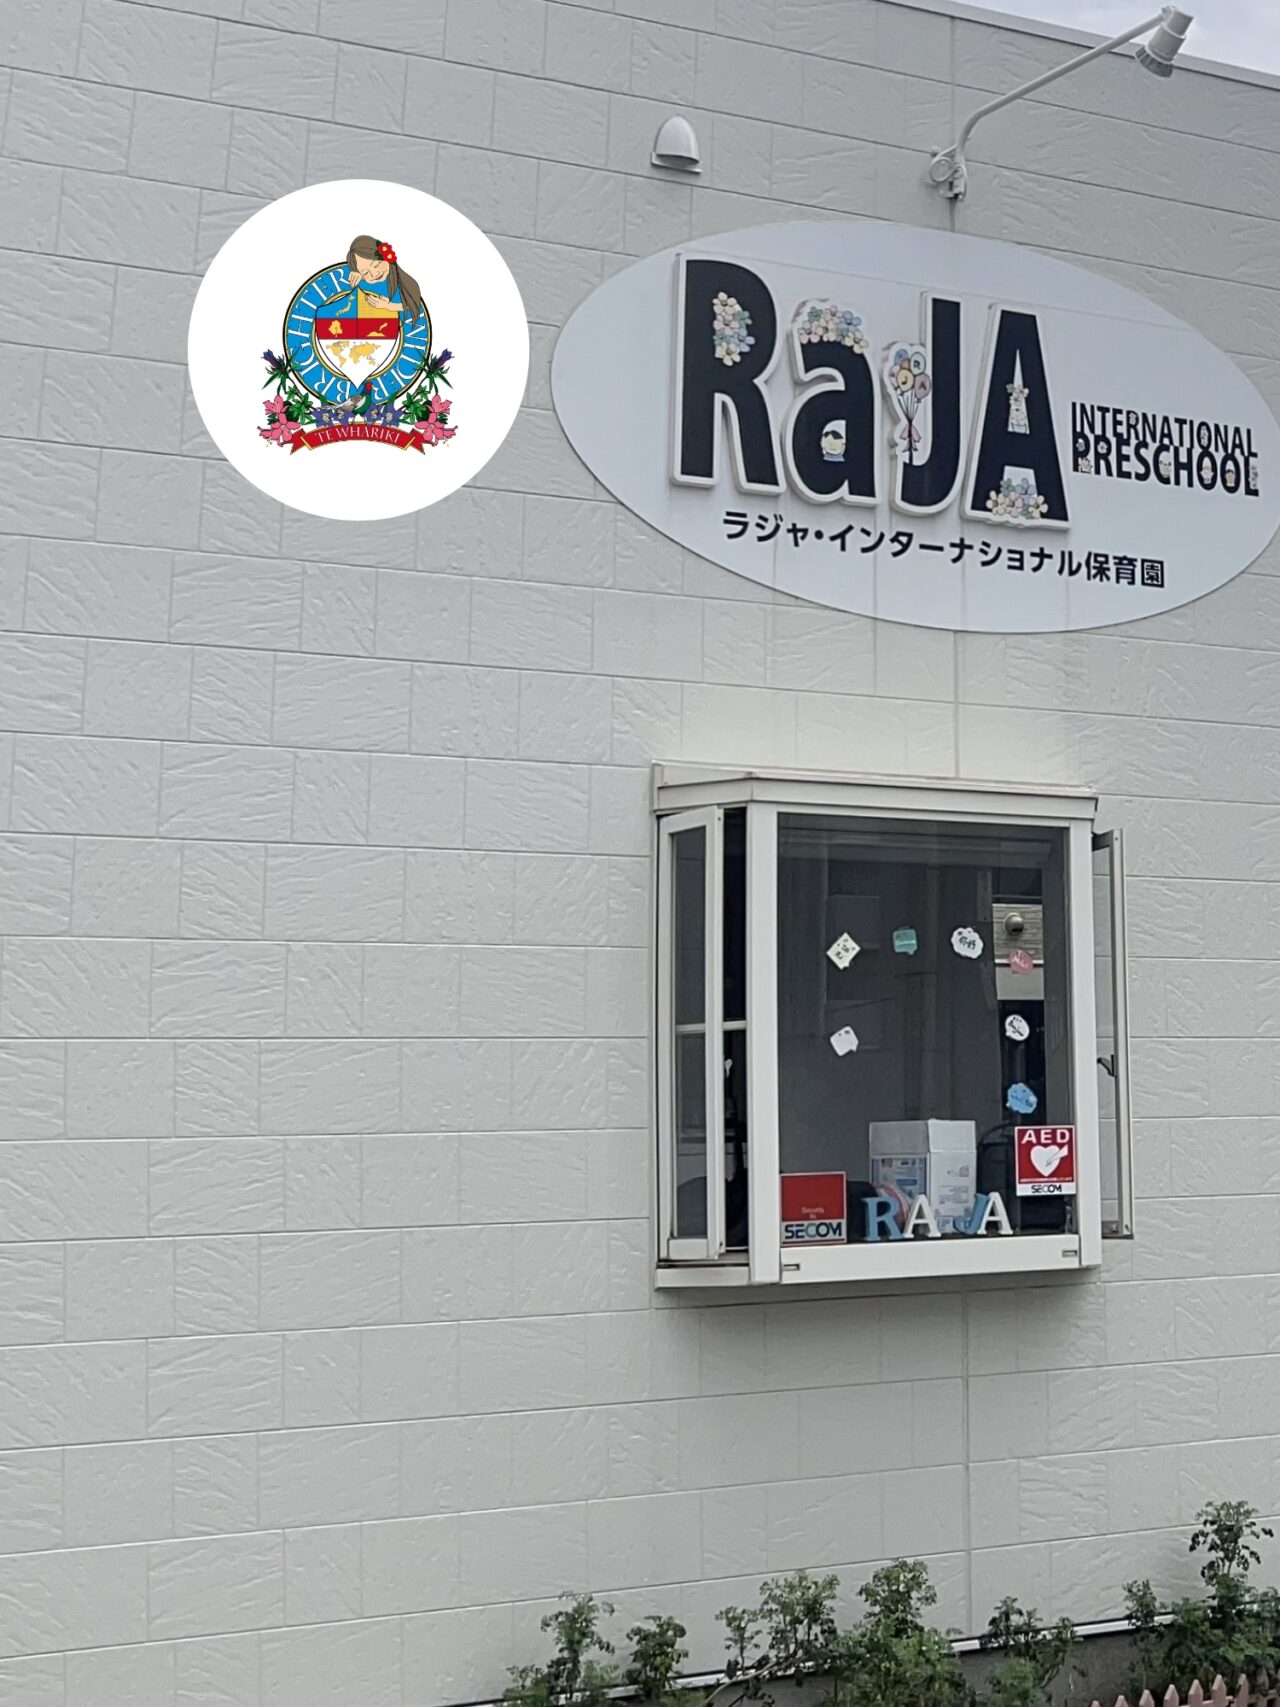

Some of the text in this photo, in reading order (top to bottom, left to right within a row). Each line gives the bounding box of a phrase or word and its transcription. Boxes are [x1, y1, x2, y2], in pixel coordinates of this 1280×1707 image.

[1071, 401, 1258, 458] INTERNATIONAL
[1072, 431, 1259, 497] PRESCHOOL
[722, 510, 1166, 589] ラジャ・インターナショナル保育園
[1021, 1128, 1070, 1145] AED
[1031, 1184, 1062, 1193] SECOM
[784, 1222, 842, 1239] SECOM
